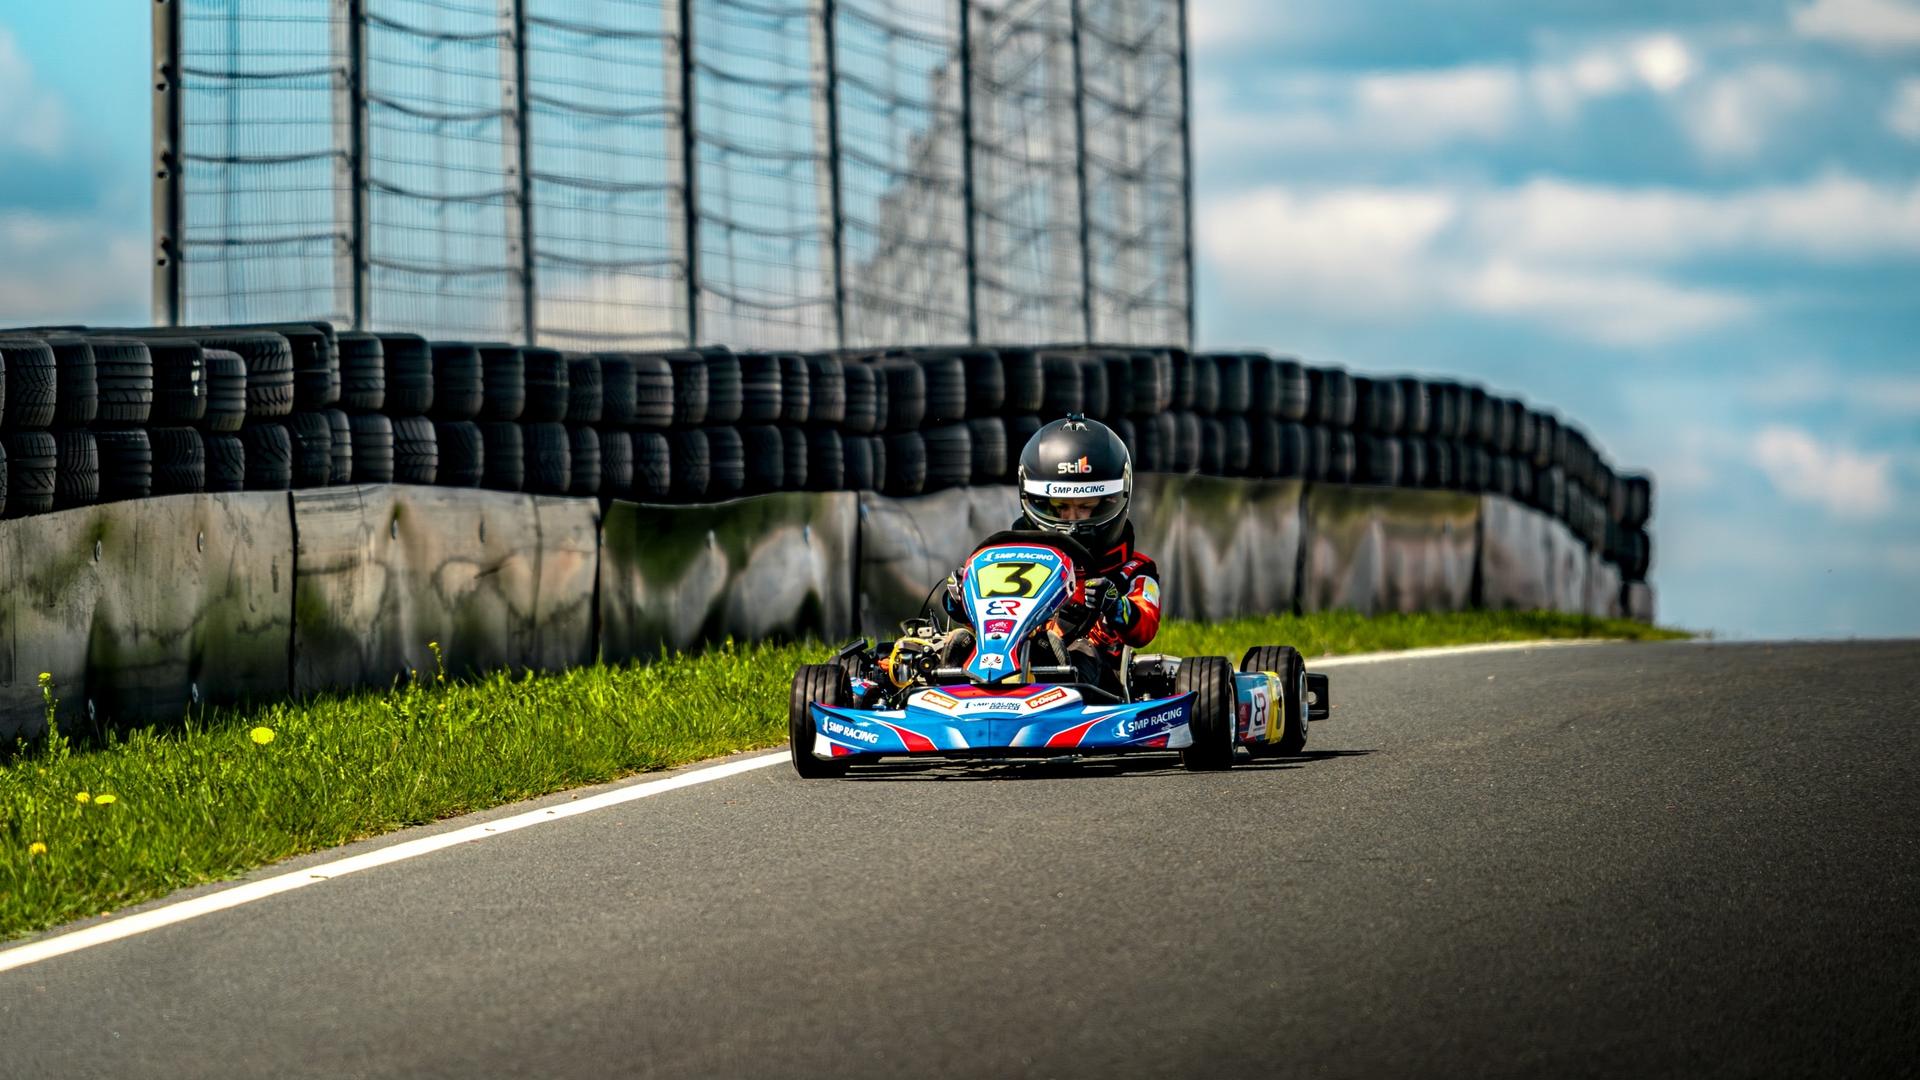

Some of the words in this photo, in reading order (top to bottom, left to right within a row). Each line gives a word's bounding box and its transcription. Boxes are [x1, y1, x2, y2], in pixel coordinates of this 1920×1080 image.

[1057, 456, 1092, 474] Stilo
[1053, 486, 1072, 494] SMP
[1073, 485, 1105, 493] RACING
[1016, 553, 1053, 561] RACING
[985, 563, 1036, 597] 3
[1127, 718, 1149, 733] SMP
[1151, 707, 1182, 726] RACING
[829, 721, 844, 733] SMP
[843, 726, 880, 744] RACING
